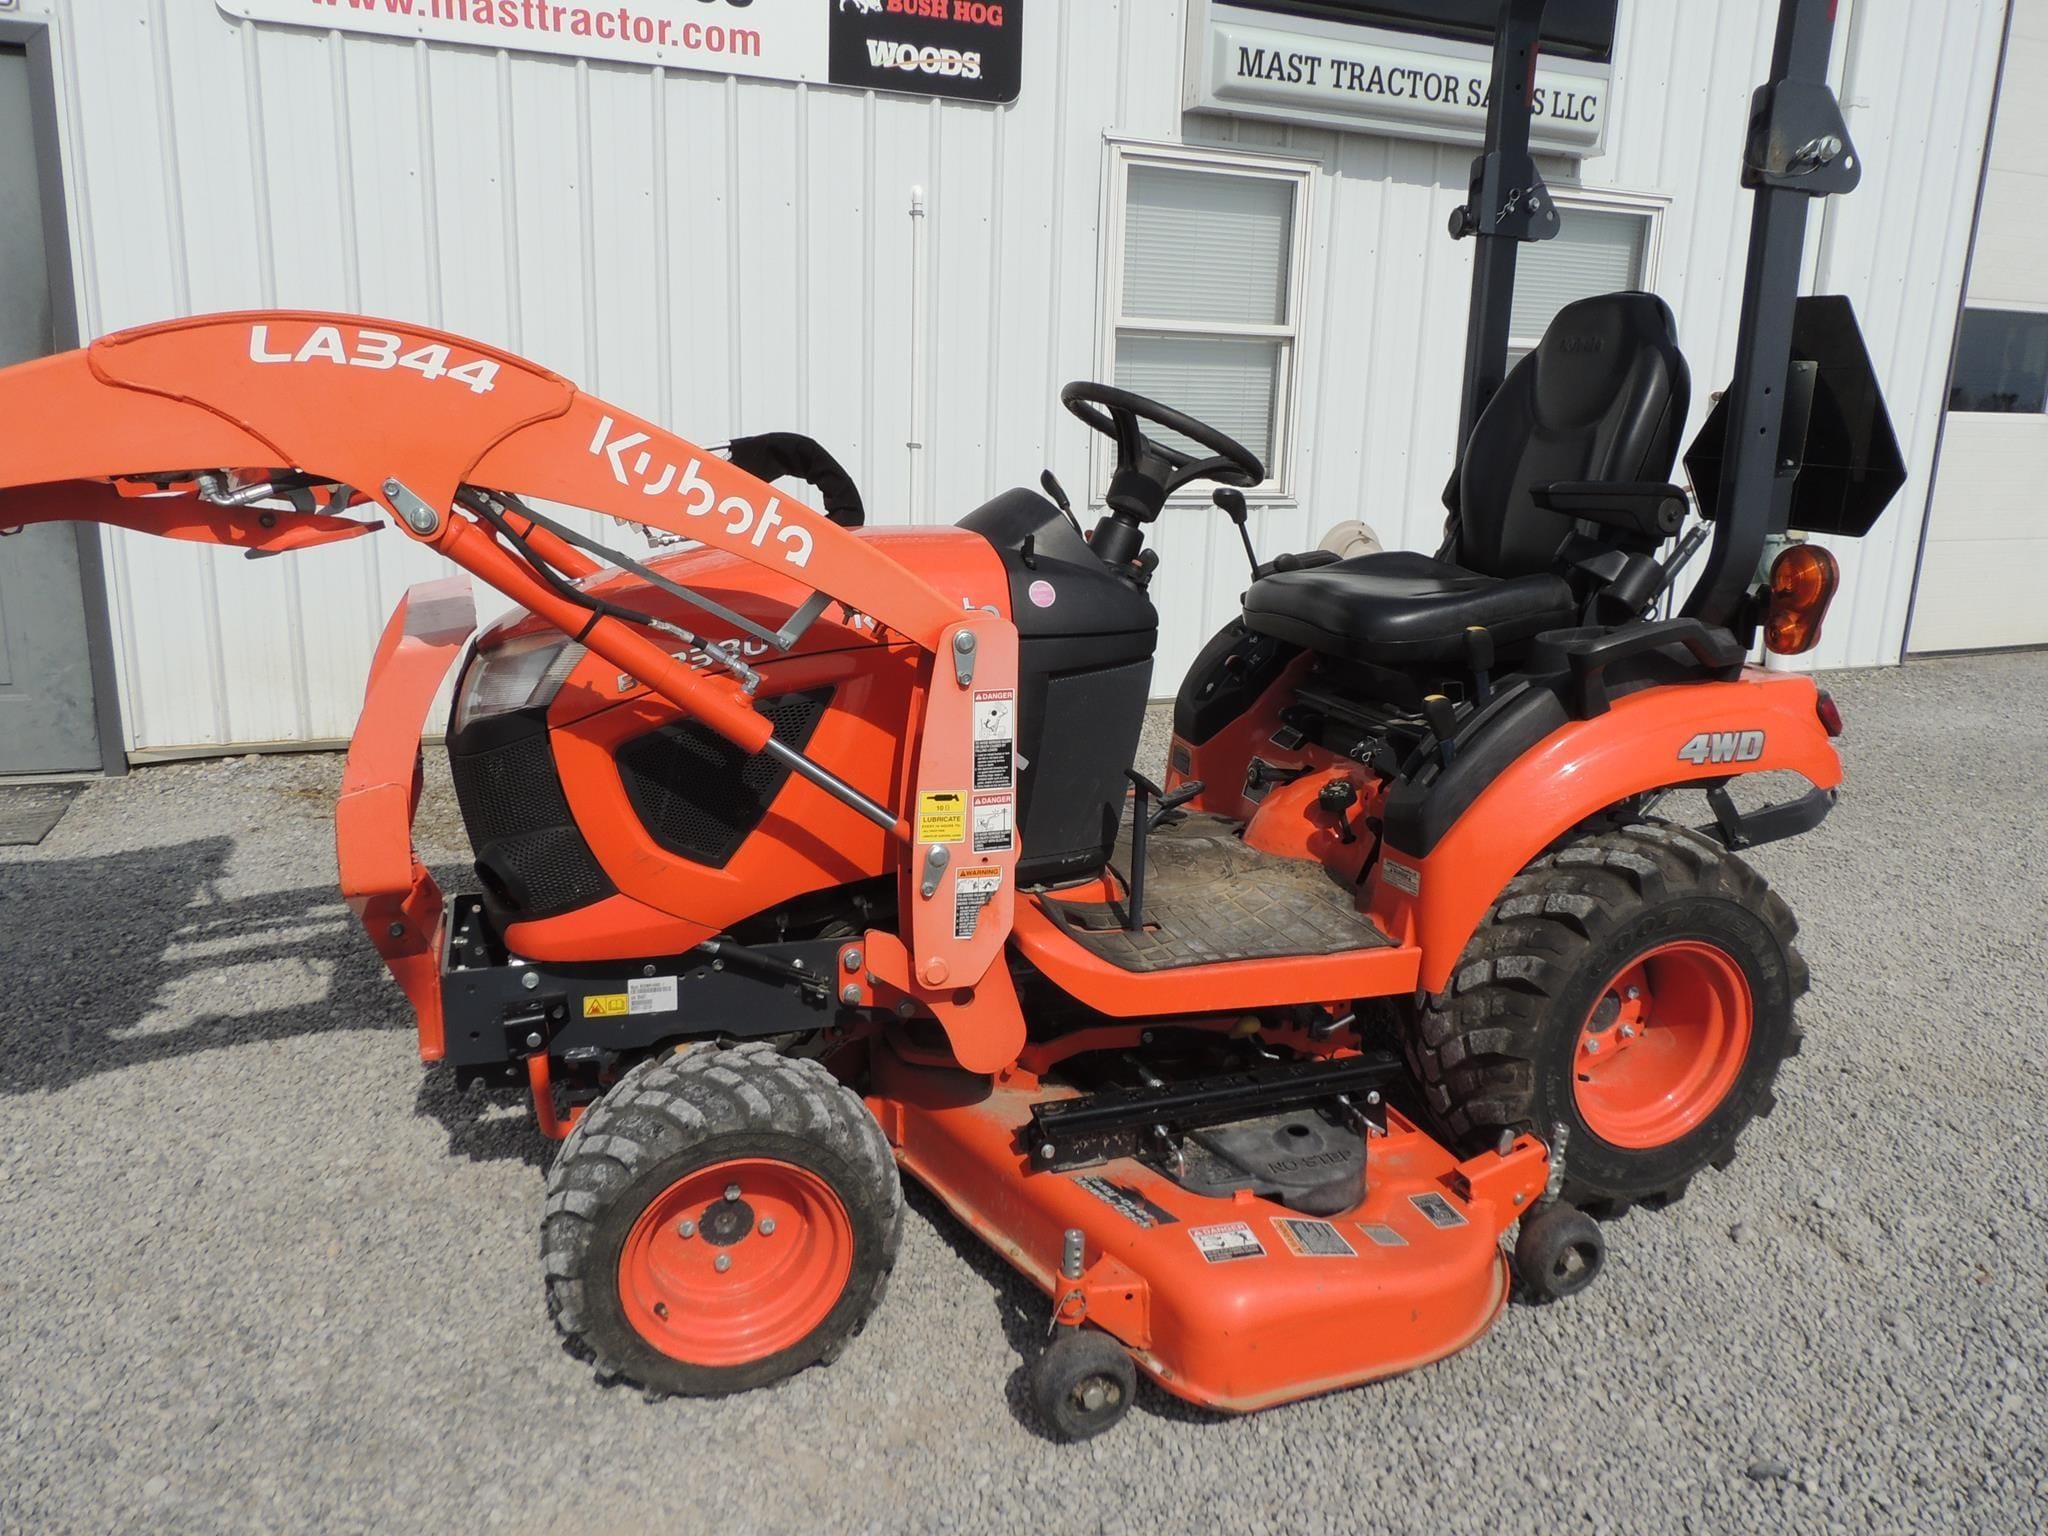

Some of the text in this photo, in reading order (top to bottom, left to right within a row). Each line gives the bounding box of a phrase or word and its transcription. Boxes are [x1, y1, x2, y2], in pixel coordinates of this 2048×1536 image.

[887, 0, 1004, 26] BUSH HOG
[1237, 46, 1322, 85] MAST
[1330, 59, 1460, 104] TRACTOR
[1550, 91, 1597, 122] LLC
[249, 325, 502, 395] LA344
[588, 415, 813, 568] Kubota
[982, 691, 1013, 700] DANGER
[1677, 729, 1766, 765] 4WD
[981, 795, 1011, 804] DANGER
[922, 815, 961, 823] LUBRICATE
[966, 868, 999, 876] WARNING
